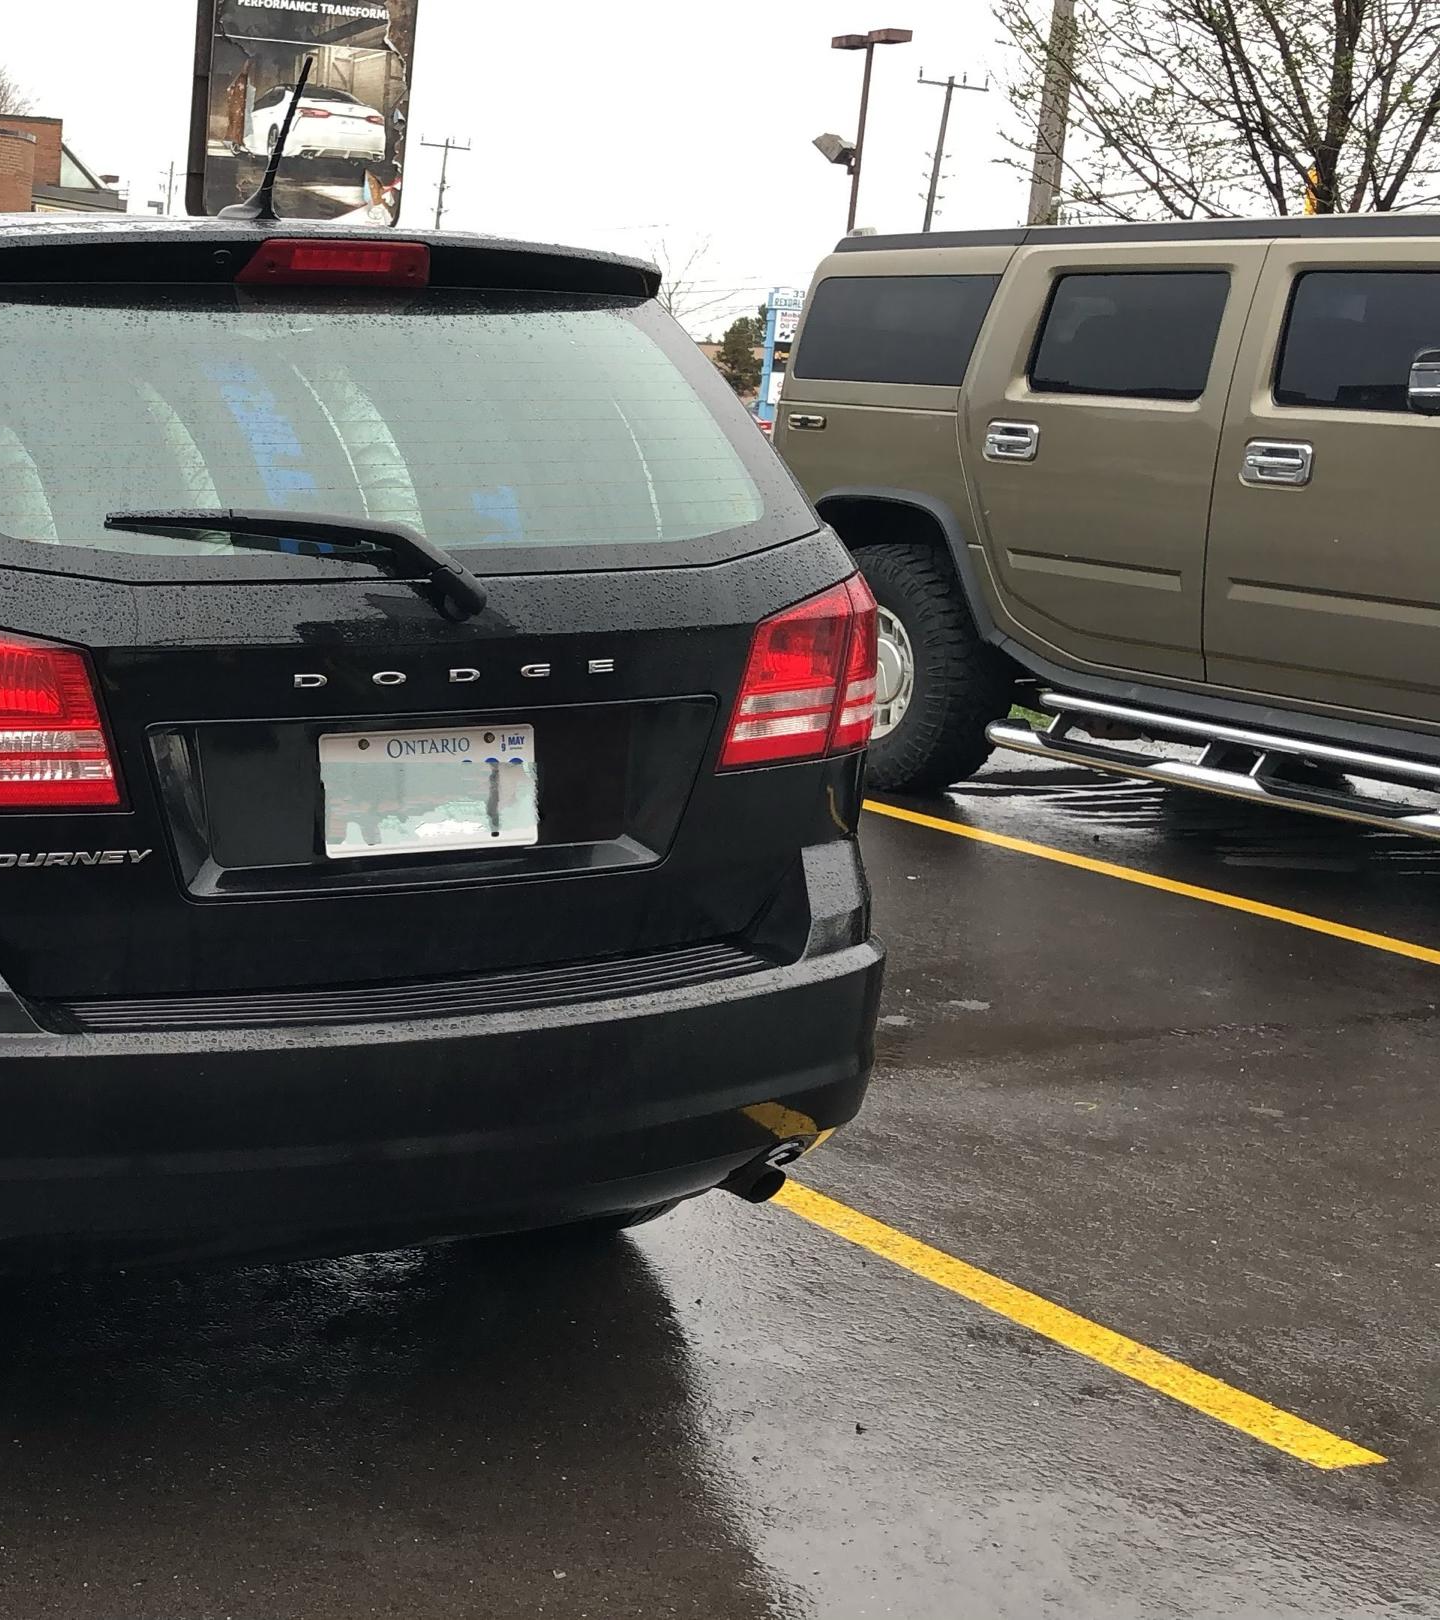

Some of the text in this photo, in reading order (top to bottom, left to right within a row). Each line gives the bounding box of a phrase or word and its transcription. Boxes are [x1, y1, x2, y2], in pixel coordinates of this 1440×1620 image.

[238, 0, 318, 13] PERFORMANCE
[293, 658, 614, 688] DODGE
[508, 735, 525, 746] MAY
